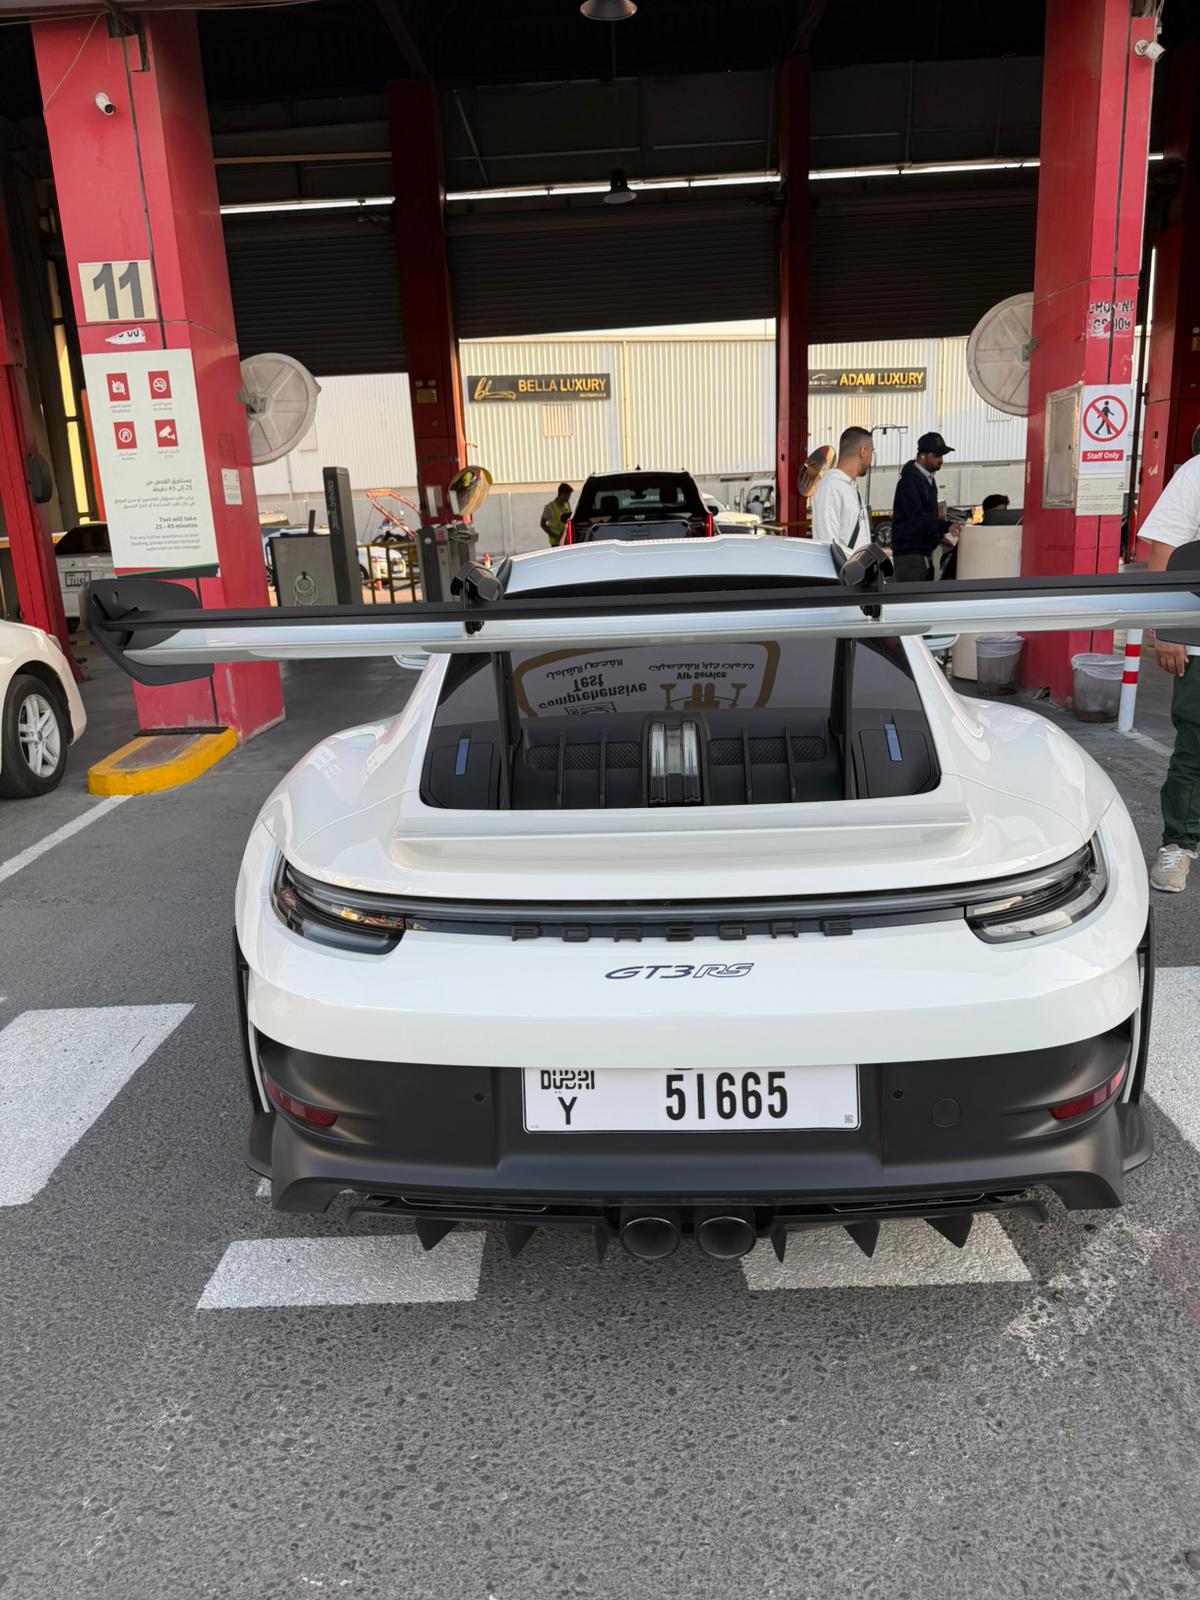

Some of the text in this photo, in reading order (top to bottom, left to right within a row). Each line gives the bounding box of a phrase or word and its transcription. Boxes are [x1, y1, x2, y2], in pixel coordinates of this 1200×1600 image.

[92, 262, 145, 320] 11
[518, 378, 606, 392] BELLA LUXURY
[840, 373, 874, 386] ADAM
[877, 372, 924, 385] LUXURY
[1087, 451, 1120, 460] Staff Only
[512, 918, 853, 942] PORSCHE
[665, 1071, 788, 1120] 51665
[557, 1096, 578, 1125] Y
